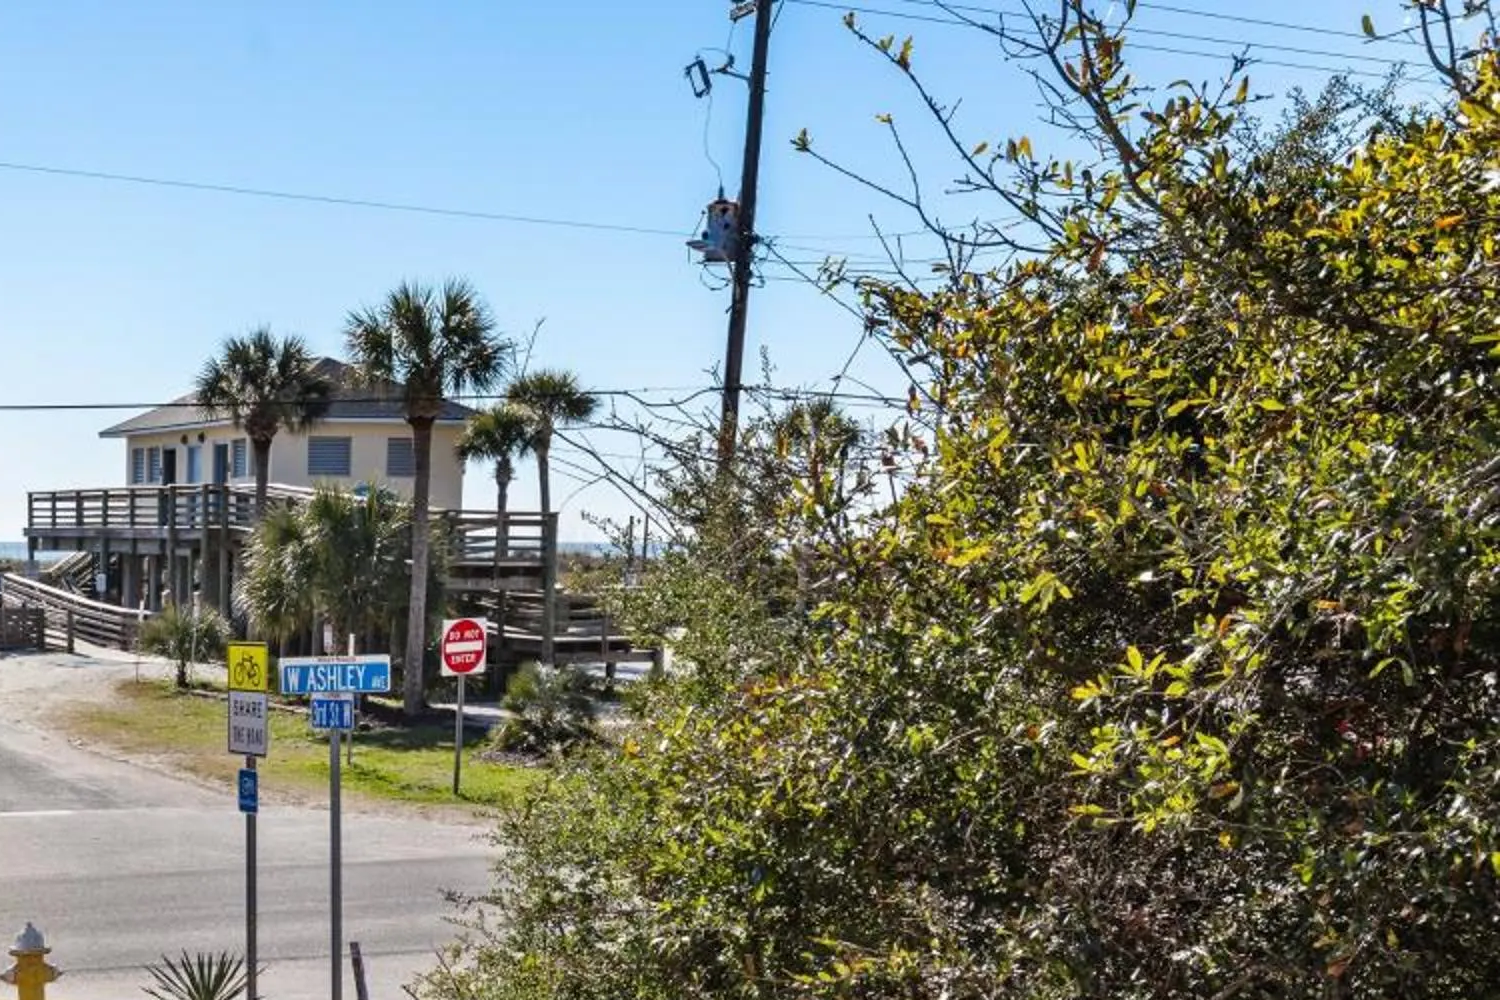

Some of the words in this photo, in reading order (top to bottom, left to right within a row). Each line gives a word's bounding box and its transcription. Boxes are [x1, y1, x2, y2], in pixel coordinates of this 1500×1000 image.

[450, 631, 461, 641] DO
[464, 629, 480, 640] NOT
[287, 667, 300, 691] W
[307, 665, 367, 692] ASHLEY
[233, 699, 263, 719] SHARE
